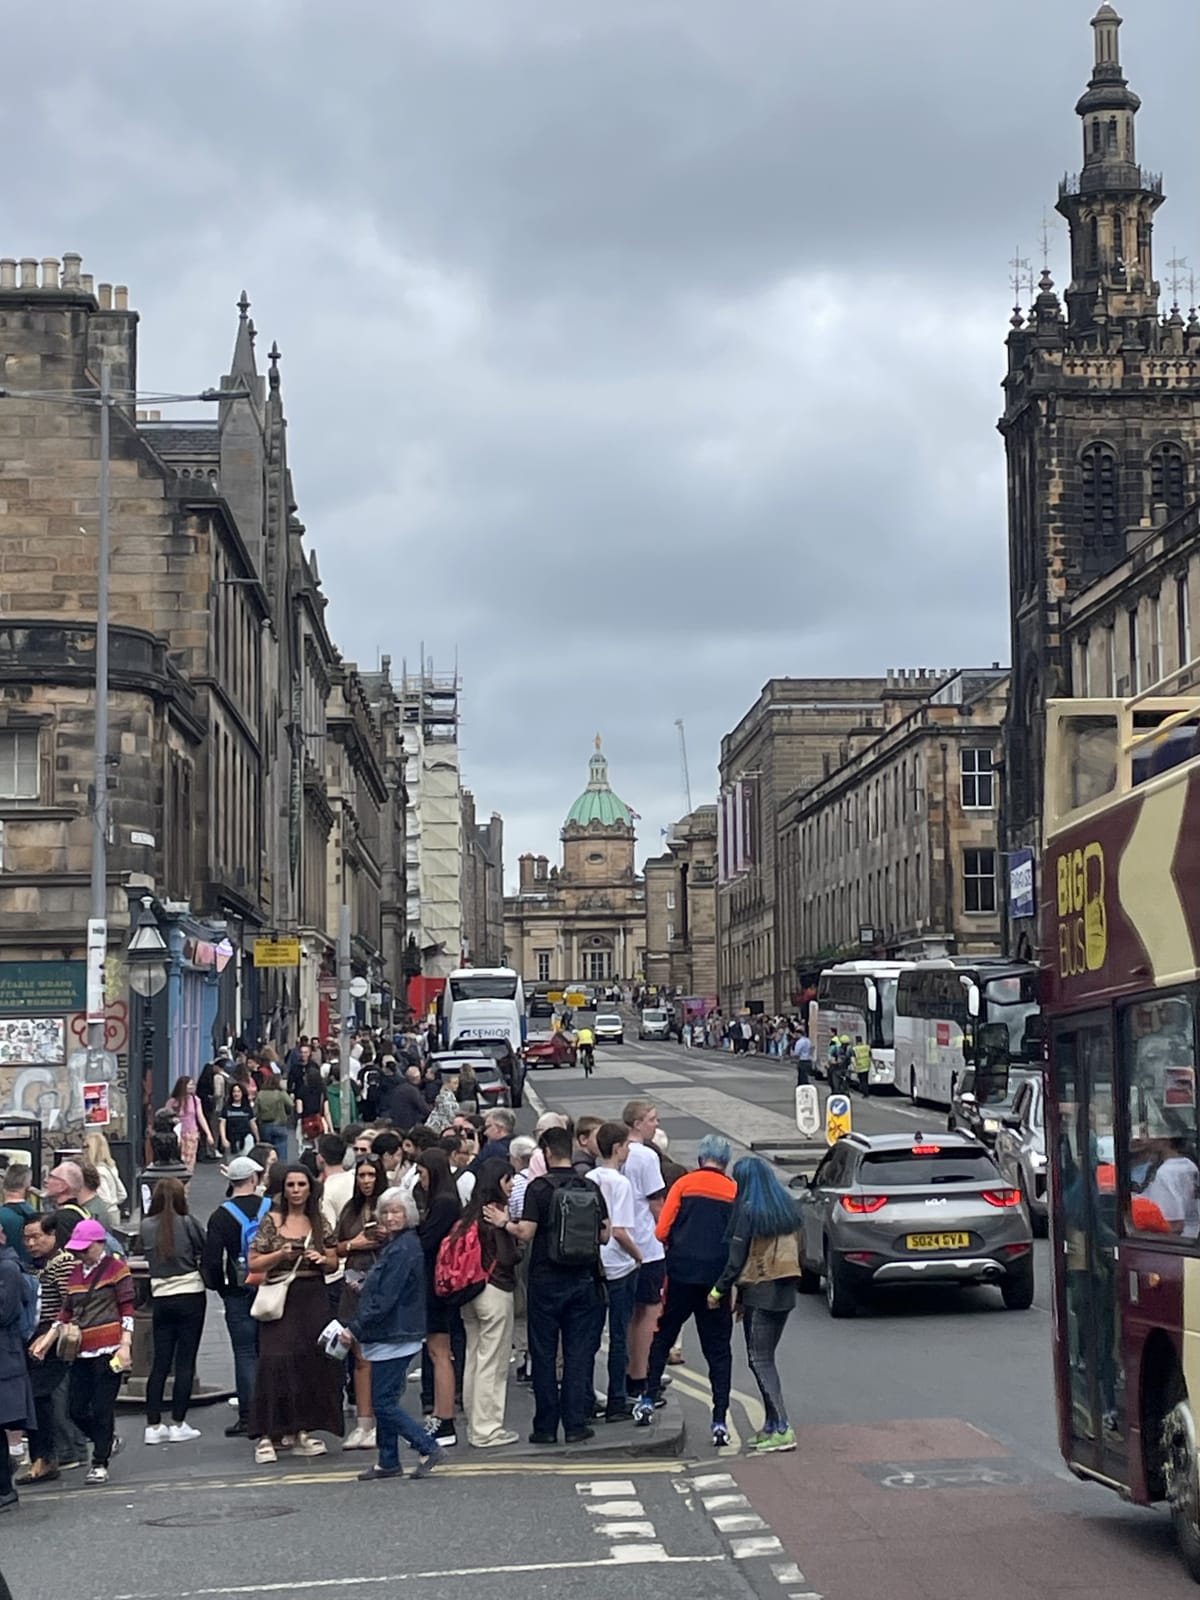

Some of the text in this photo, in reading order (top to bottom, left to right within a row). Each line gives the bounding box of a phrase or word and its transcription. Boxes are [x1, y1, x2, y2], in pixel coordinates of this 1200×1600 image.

[1058, 849, 1083, 916] BIG
[1059, 917, 1085, 978] BUS
[472, 1028, 511, 1038] SENIOR
